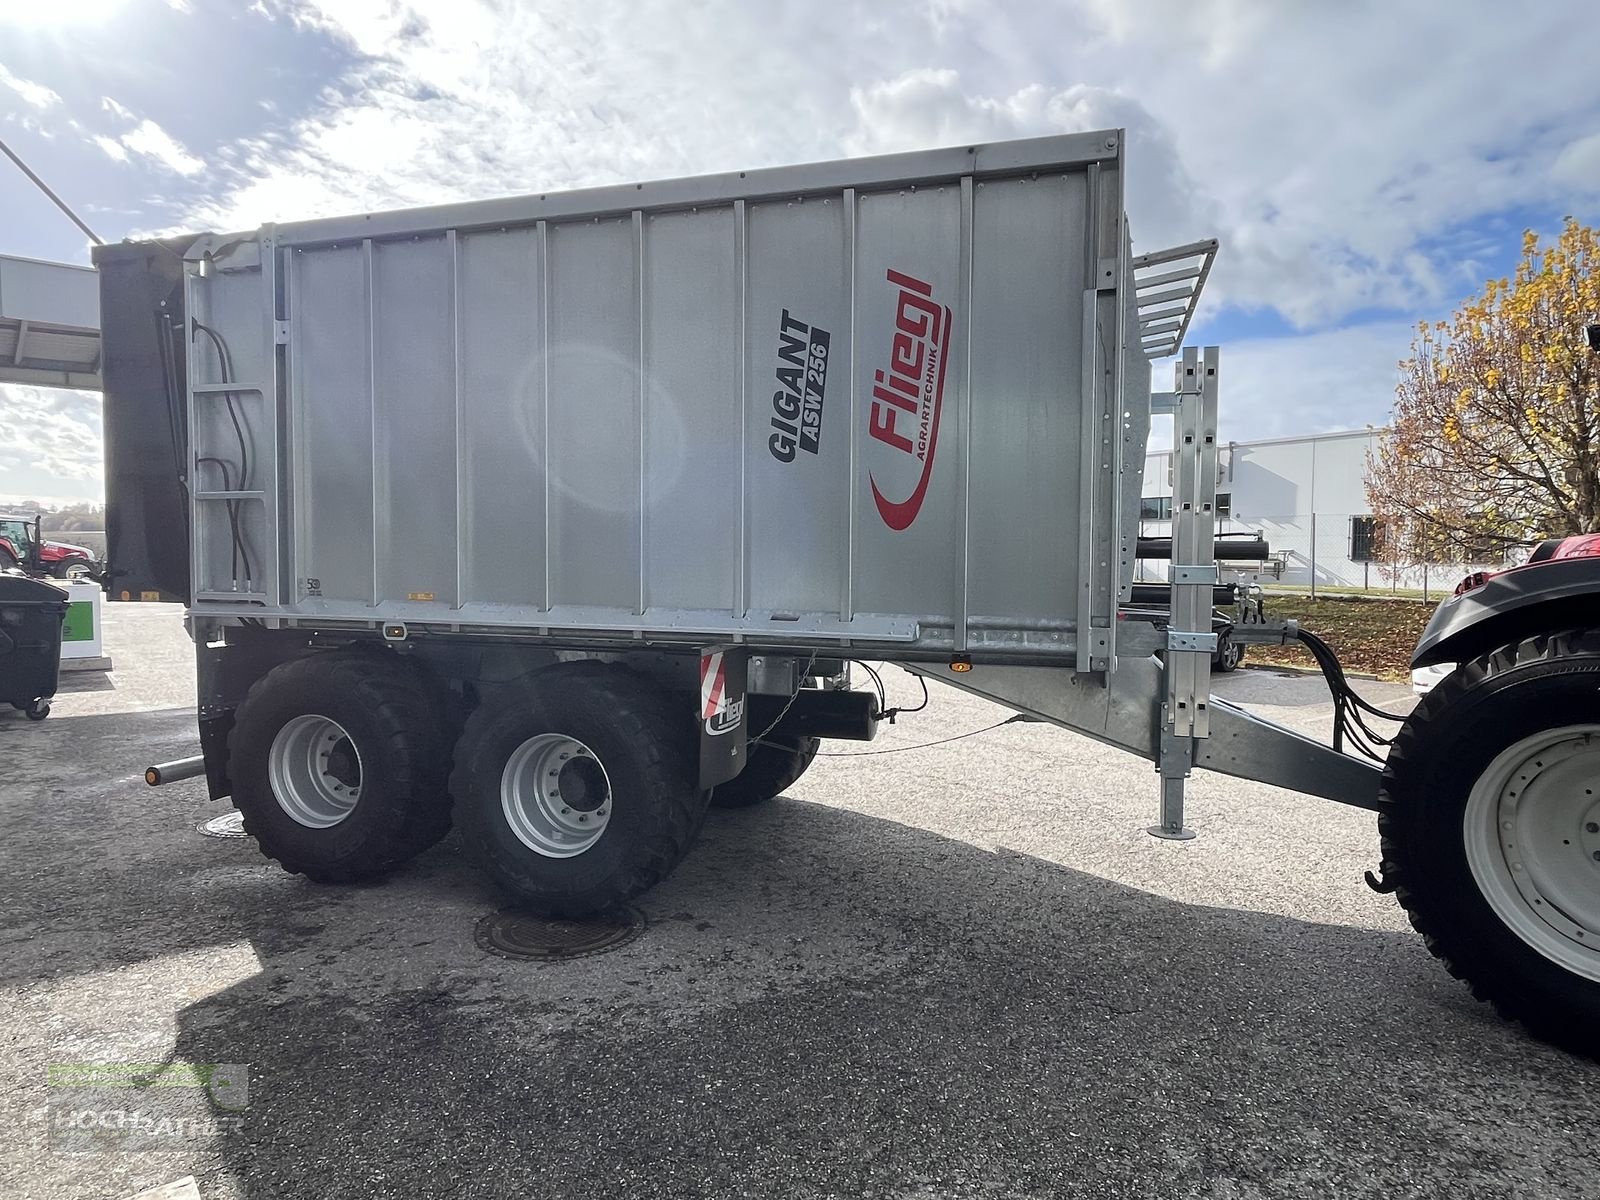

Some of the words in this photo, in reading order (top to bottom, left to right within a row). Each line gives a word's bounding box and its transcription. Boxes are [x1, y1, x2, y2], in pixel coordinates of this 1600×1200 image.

[768, 308, 809, 463] GIGANT
[801, 389, 823, 442] ASW
[808, 342, 827, 385] 256
[869, 268, 942, 454] Fliegl
[917, 347, 938, 462] AGRARTECHNIK
